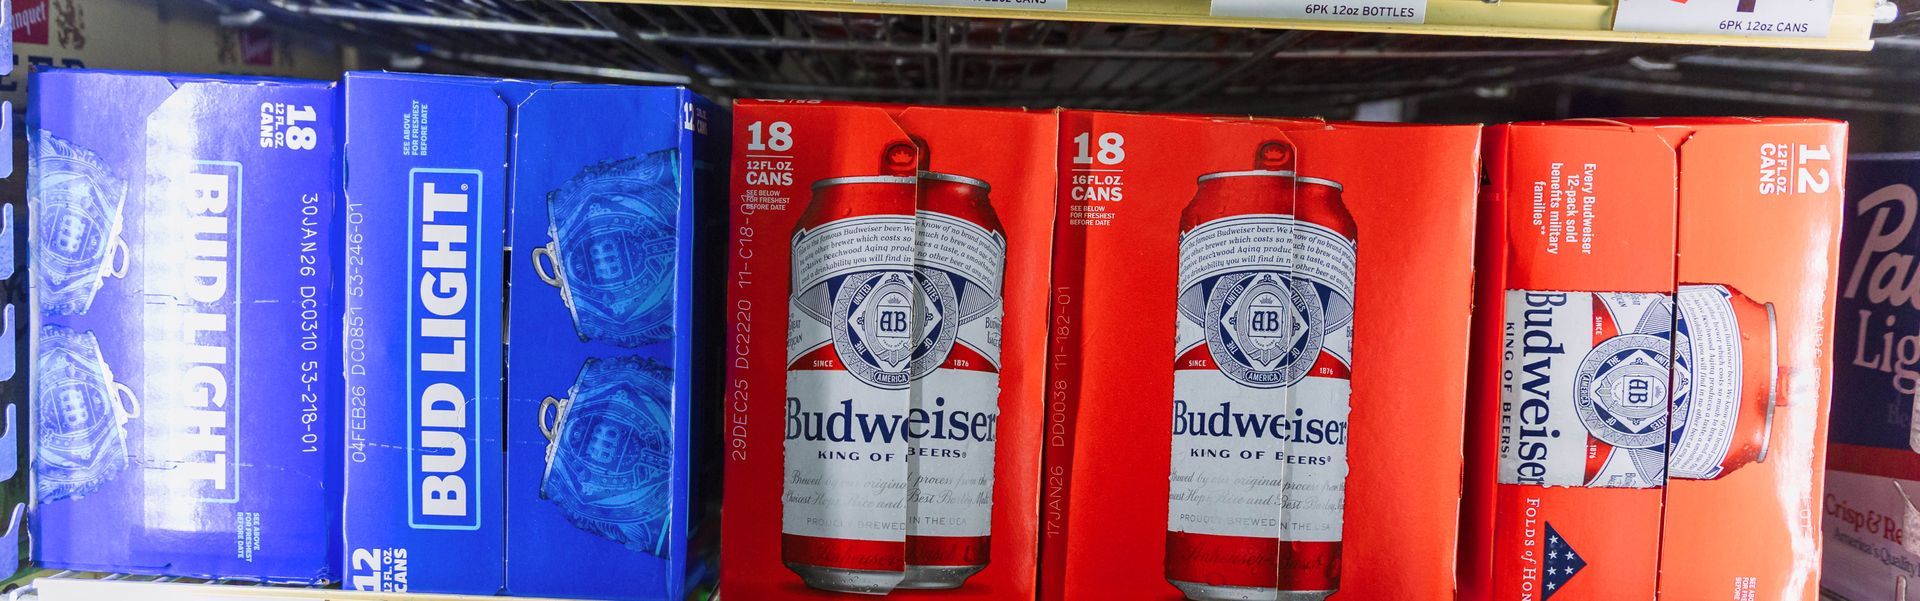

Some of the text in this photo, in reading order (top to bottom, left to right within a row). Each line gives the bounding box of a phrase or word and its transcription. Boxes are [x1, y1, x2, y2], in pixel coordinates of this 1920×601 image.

[1305, 4, 1414, 18] 6PK 12oz BOTTLES
[1719, 20, 1808, 33] 6PK 12oz CANS
[275, 103, 284, 115] 12
[260, 102, 274, 148] CANS
[285, 105, 317, 150] 18
[420, 125, 428, 156] BEFORE
[747, 121, 794, 152] 18
[403, 141, 411, 156] SEE
[1073, 132, 1126, 165] 18
[746, 171, 793, 187] CANS
[1759, 143, 1776, 195] CANS
[1797, 144, 1831, 194] 12
[1071, 186, 1123, 202] CANS
[1547, 162, 1564, 255] benefits military
[1565, 174, 1580, 243] 12-pack sold
[1582, 163, 1597, 255] Every Budweiser
[831, 239, 855, 249] brewer
[856, 235, 879, 243] which
[880, 233, 901, 242] costs
[843, 225, 884, 236] Budweiser
[1216, 226, 1256, 238] Budweiser
[1256, 225, 1275, 234] beer.
[1276, 226, 1288, 234] We
[1205, 240, 1228, 251] brewer
[1229, 236, 1251, 245] which
[869, 254, 884, 262] will
[885, 254, 902, 264] find
[852, 283, 872, 306] UNITED
[920, 279, 940, 303] STATES
[1225, 285, 1245, 306] UNITED
[300, 193, 318, 452] 30JAN26 DC0310 53-218-01
[349, 203, 366, 463] 04FEB26 DC0851 53-246-01
[879, 311, 907, 333] AB
[1055, 286, 1071, 371] 11-182-01
[1252, 311, 1279, 333] AB
[1595, 316, 1603, 337] SINCE
[735, 300, 752, 369] DC2220
[420, 182, 468, 516] BUD LIGHT
[853, 341, 867, 357] THE
[1226, 341, 1238, 355] THE
[812, 358, 834, 368] SINCE
[953, 359, 970, 368] 1876
[1188, 359, 1207, 367] SINCE
[1319, 367, 1334, 375] 1876
[1606, 355, 1621, 367] THE
[876, 372, 909, 384] AMERICA
[1247, 372, 1279, 382] AMERICA
[1500, 321, 1515, 454] KING OF BEERS
[1516, 292, 1567, 485] Budweiser
[1628, 379, 1649, 404] AB
[732, 379, 749, 461] 29DEC25
[786, 396, 996, 444] Budweiser
[1173, 400, 1347, 445] Budweiser
[818, 450, 860, 462] KING
[869, 452, 895, 462] OF
[1190, 448, 1326, 466] KING OF BEERS
[1047, 466, 1064, 539] 17JAN26
[1824, 493, 1865, 533] Crisp
[924, 516, 946, 526] THE
[1292, 523, 1312, 531] THE
[1524, 498, 1541, 547] FOLDS
[1521, 550, 1537, 565] of
[352, 548, 381, 592] 12
[394, 548, 408, 593] CANS
